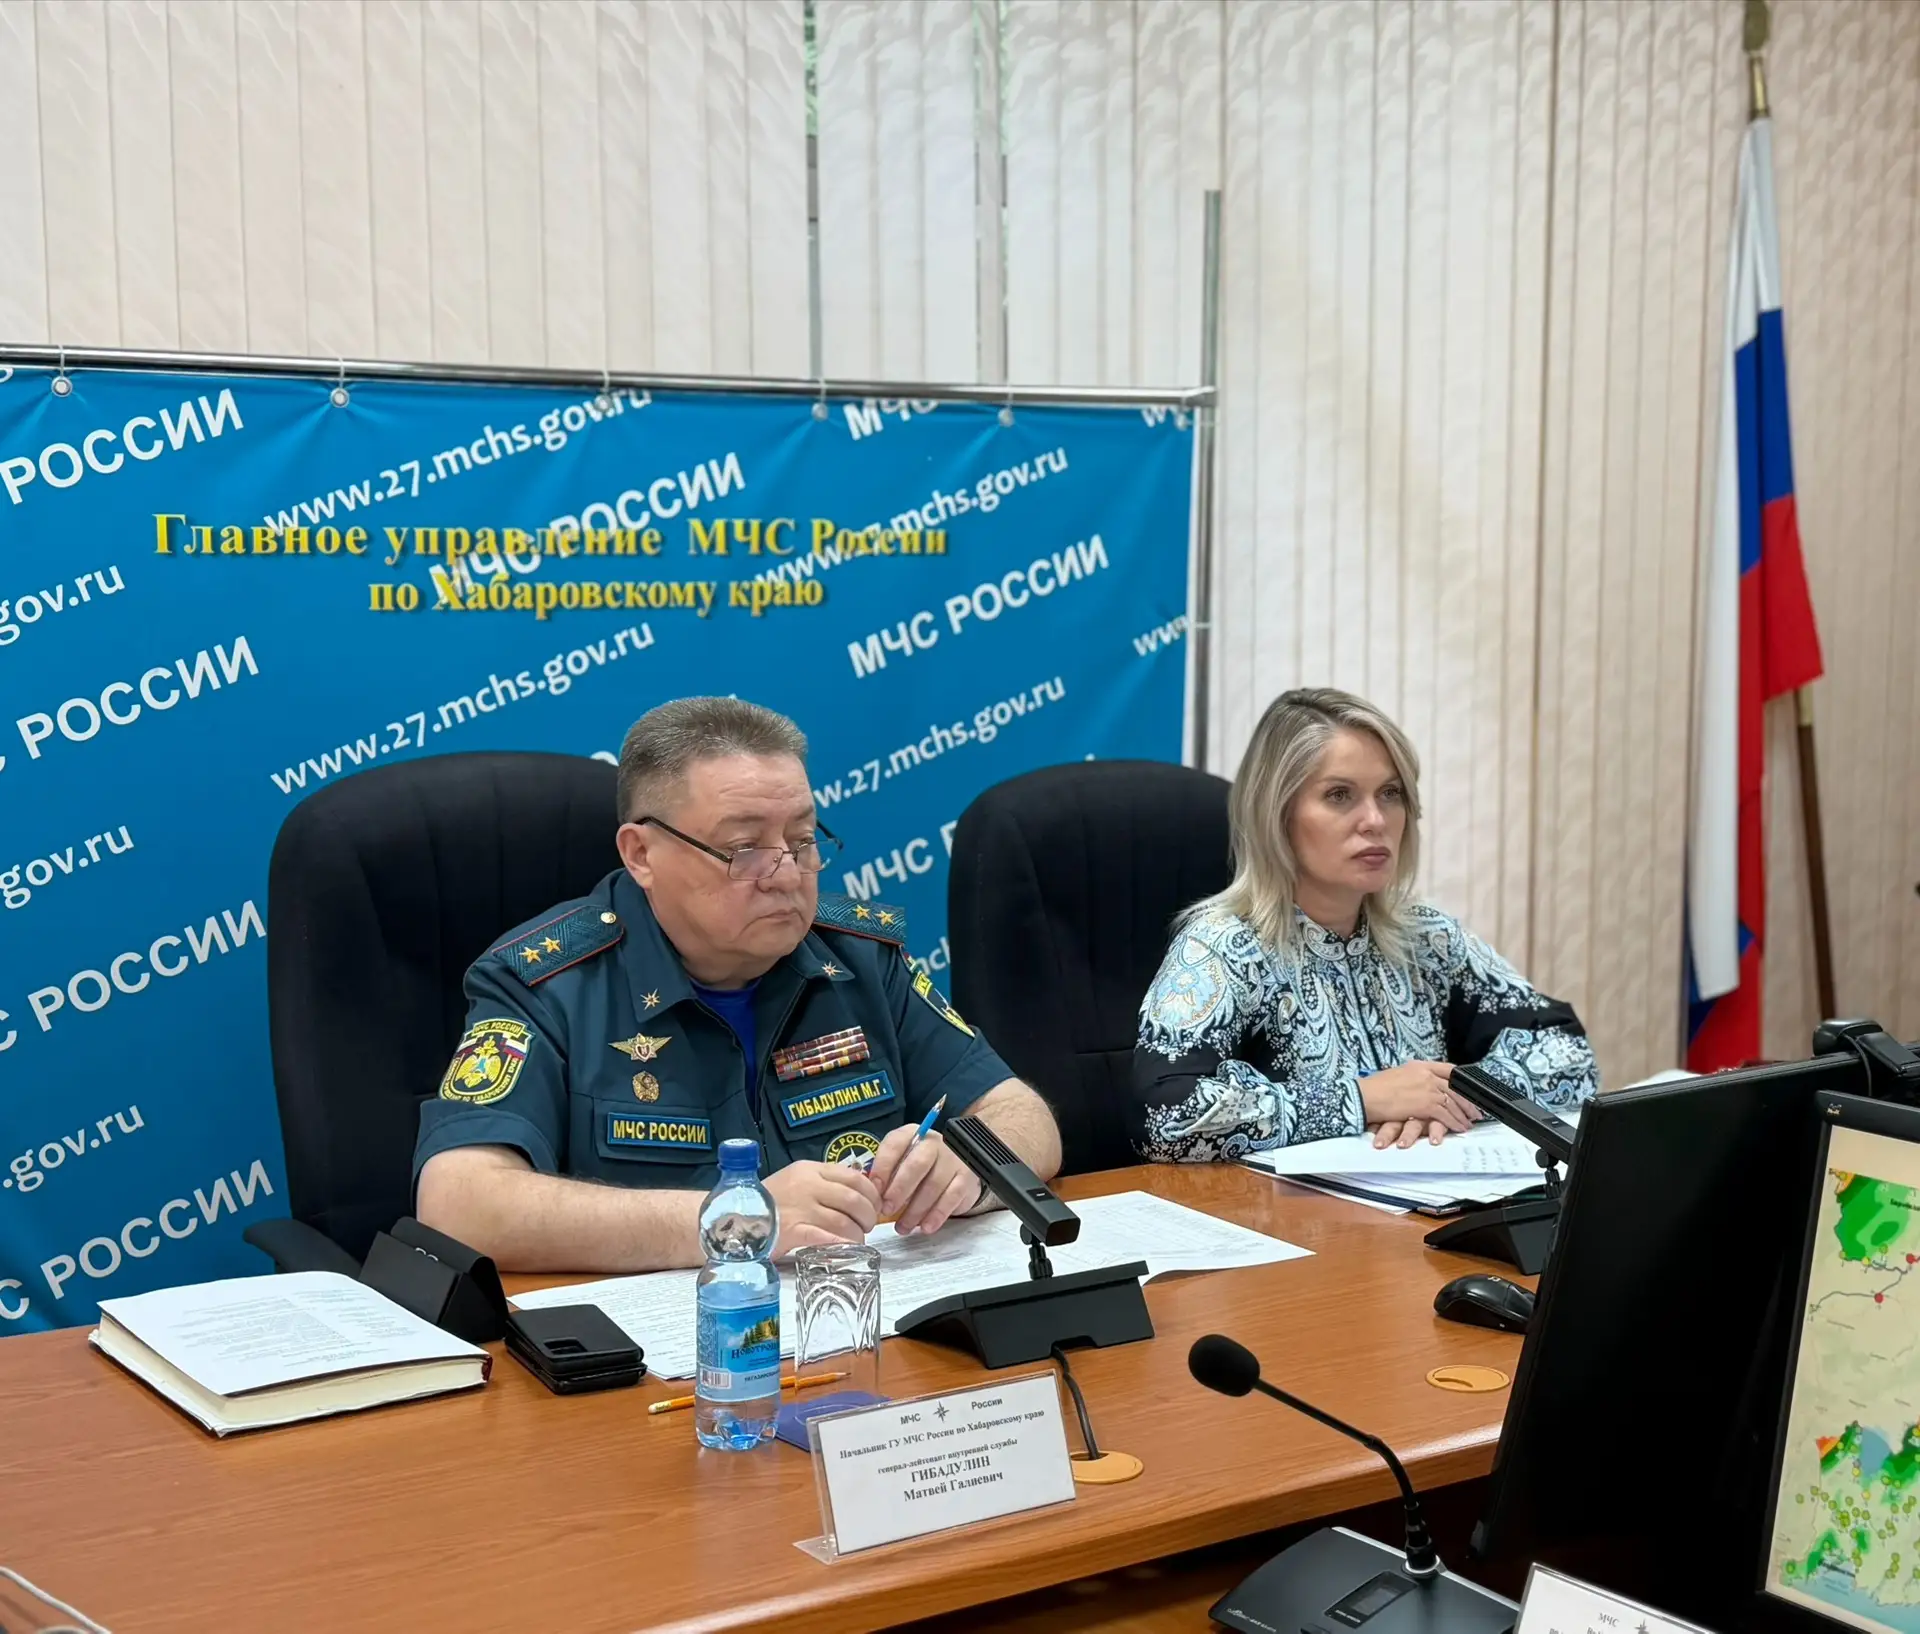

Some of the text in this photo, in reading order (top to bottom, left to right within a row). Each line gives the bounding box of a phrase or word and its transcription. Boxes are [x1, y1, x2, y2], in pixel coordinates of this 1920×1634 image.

[0, 388, 244, 505] РОССИИ
[550, 452, 746, 559] РОССИИ
[152, 514, 947, 564] Главное управление МЧС России
[368, 573, 823, 619] по Хабаровскому краю
[847, 533, 1109, 679] МЧС РОССИИ
[16, 635, 259, 760] РОССИИ
[271, 622, 655, 794] www.27.mchs.gov.ru
[0, 825, 134, 909] gov.ru
[843, 837, 933, 901] МЧС
[28, 900, 267, 1032] РОССИИ
[788, 1078, 887, 1121] ГИБАДУЛИН М.Г.
[613, 1119, 706, 1144] МЧС РОССИИ
[828, 1134, 877, 1164] ЧС РОССИ
[40, 1160, 274, 1300] РОССИИ
[839, 1409, 1045, 1460] Начальник ГУ МЧС России по Хабаровскому краю
[900, 1398, 1003, 1426] МЧС России
[877, 1437, 1018, 1475] генерал-лейтенант внутренней службы
[911, 1455, 990, 1483] ГИБАДУЛИН
[903, 1471, 1003, 1502] Матвей Галиевич
[1599, 1611, 1619, 1628] МЧС
